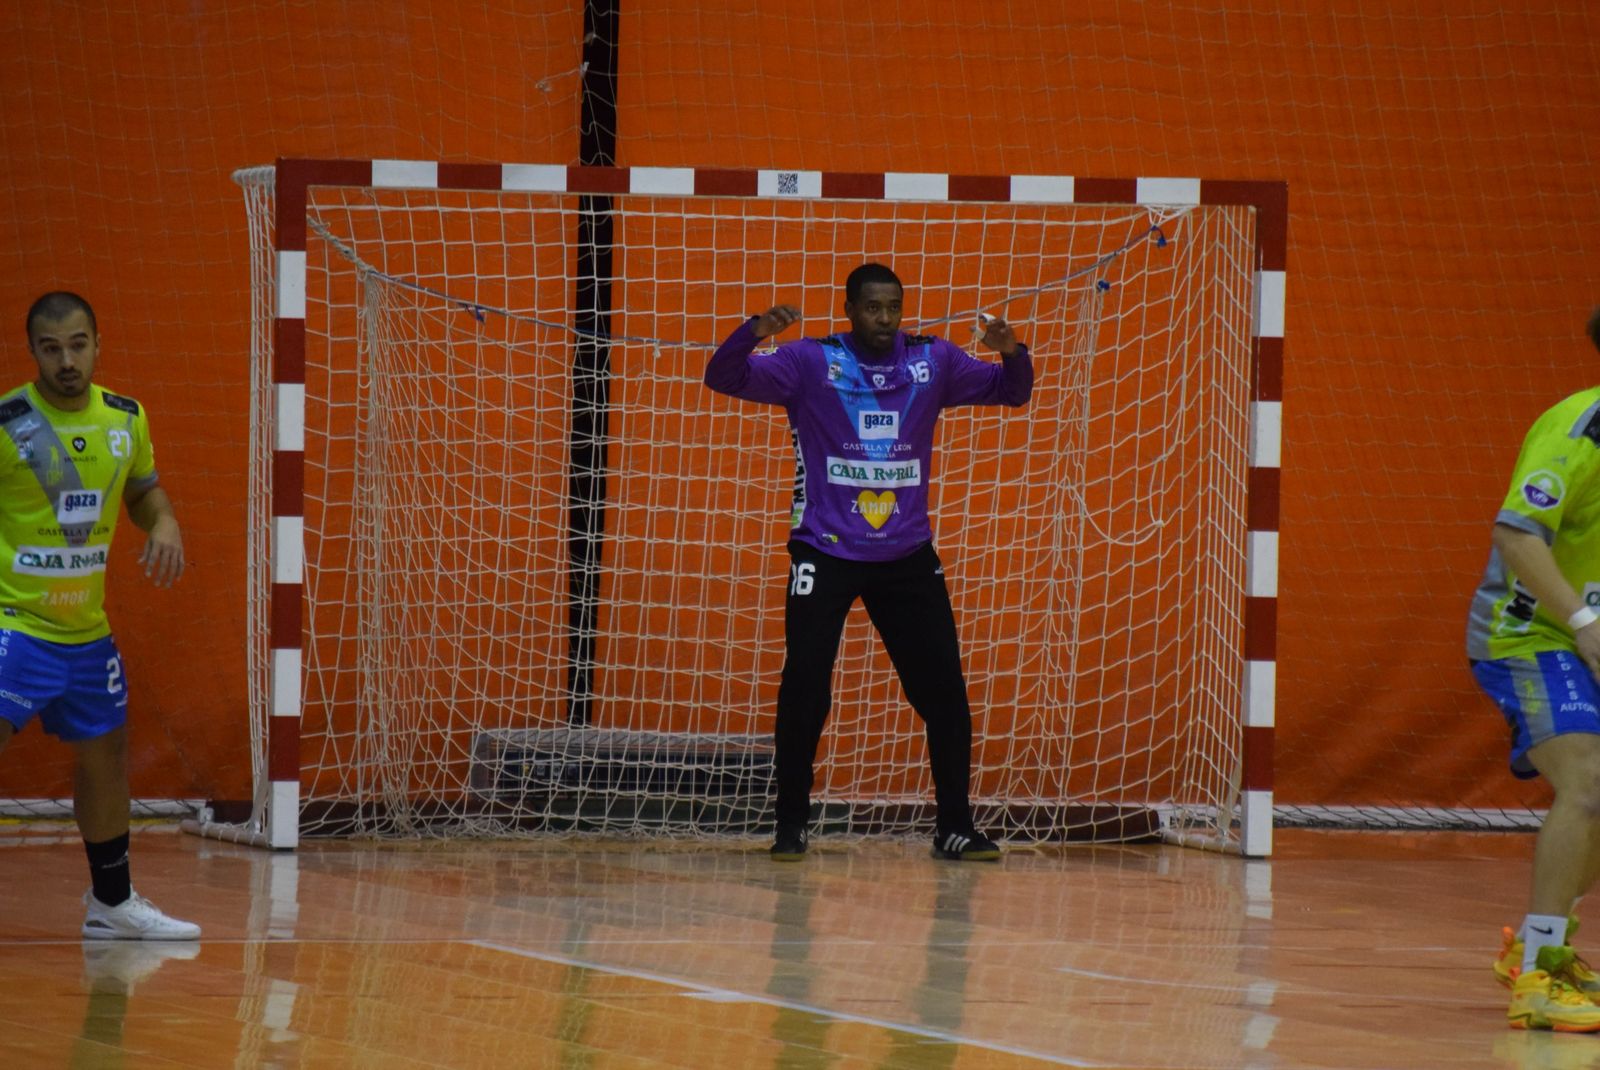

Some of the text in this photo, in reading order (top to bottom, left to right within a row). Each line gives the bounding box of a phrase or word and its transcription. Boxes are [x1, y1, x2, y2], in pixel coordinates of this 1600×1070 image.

[908, 360, 930, 383] 16
[864, 414, 894, 430] gaza
[108, 430, 131, 457] 27
[843, 443, 882, 452] CASTILLA
[885, 444, 891, 453] Y
[829, 463, 870, 481] CAJA
[64, 493, 97, 512] gaza
[18, 550, 107, 570] CAJA RURA
